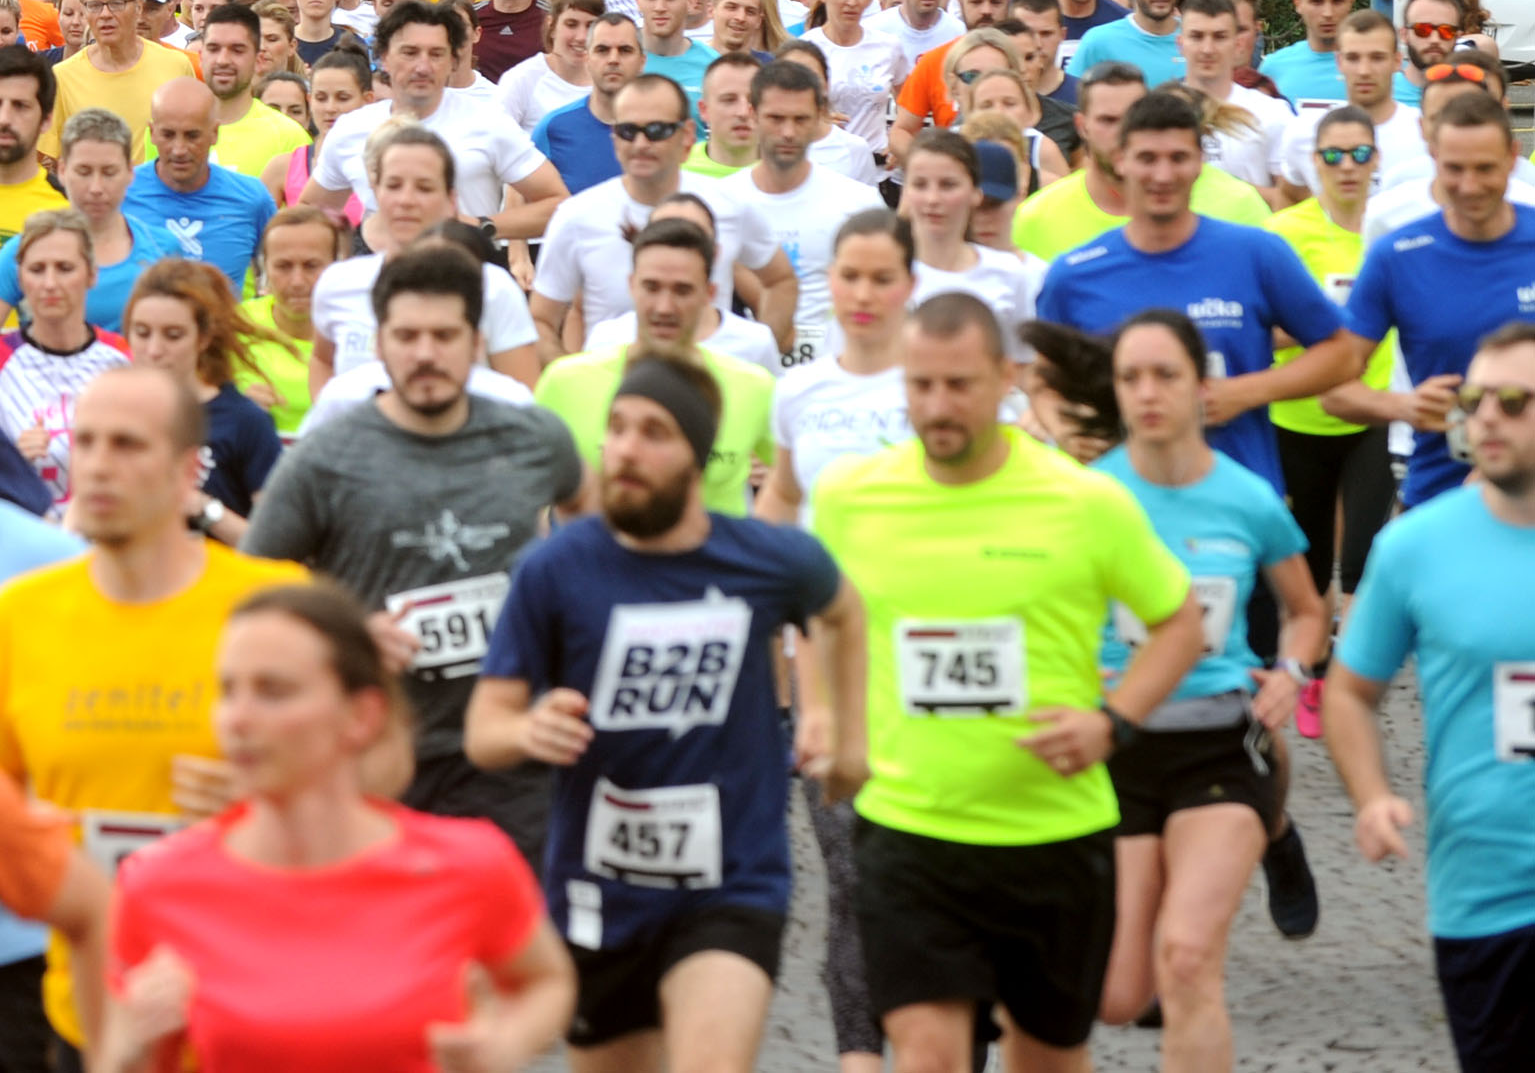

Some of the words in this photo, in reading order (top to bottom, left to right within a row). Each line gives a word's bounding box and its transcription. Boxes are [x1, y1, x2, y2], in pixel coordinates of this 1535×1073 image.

[417, 610, 491, 656] 591
[620, 642, 731, 679] B2B
[917, 649, 999, 689] 745
[608, 684, 721, 719] RUN
[610, 822, 692, 860] 457
